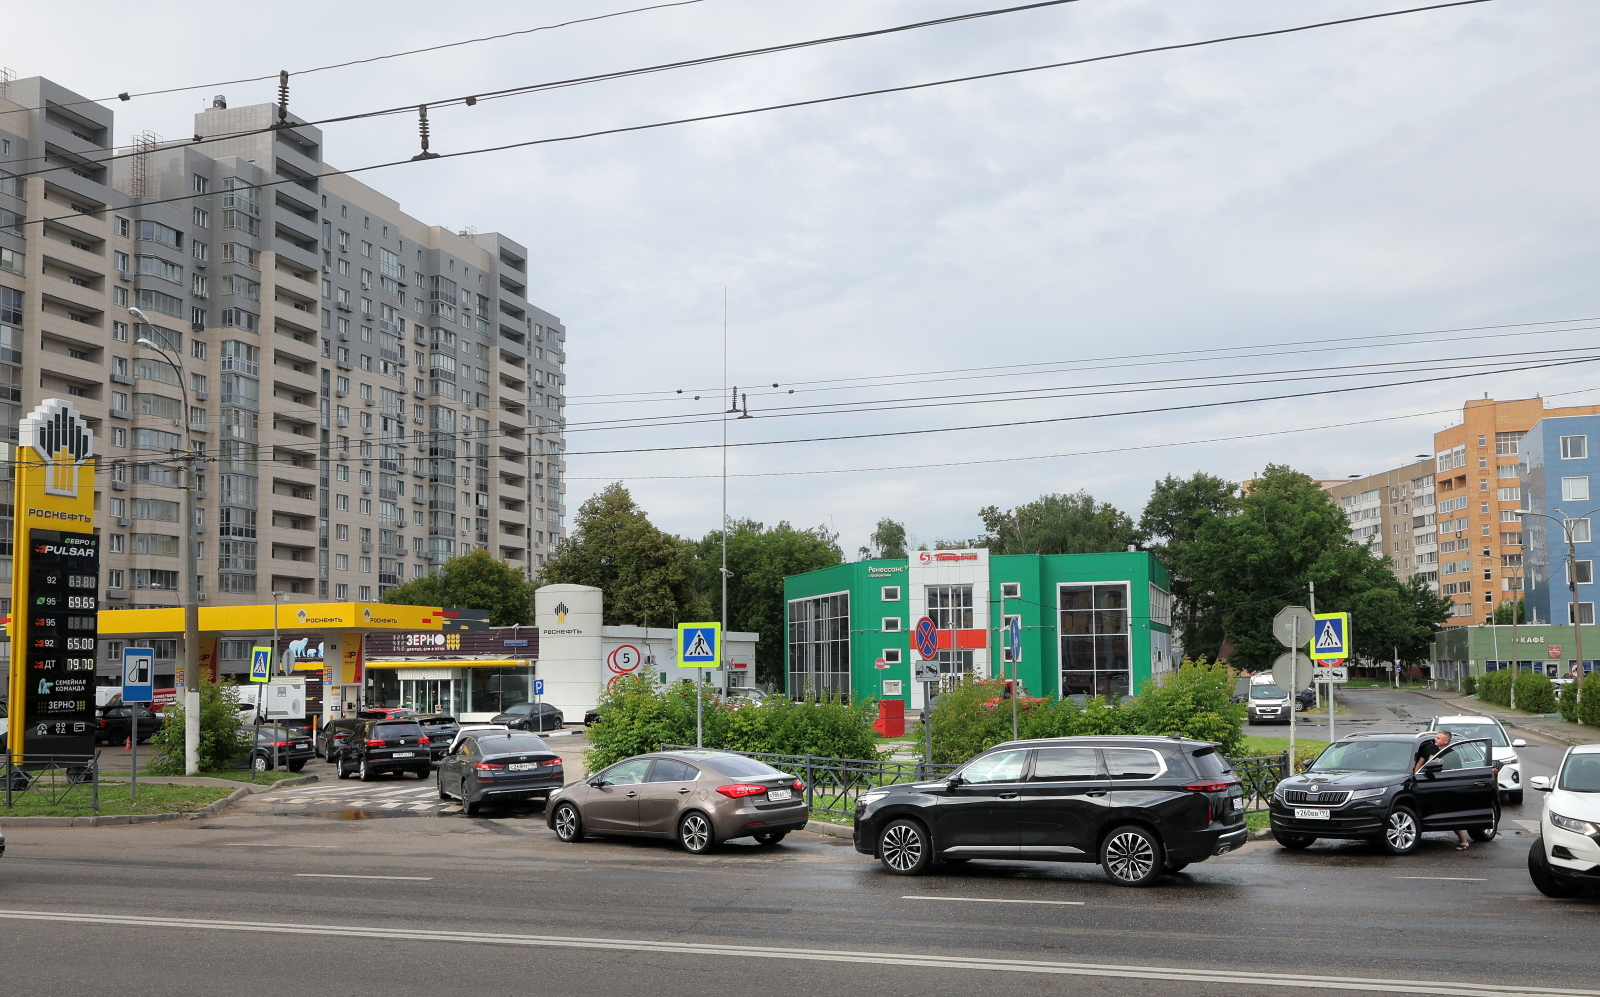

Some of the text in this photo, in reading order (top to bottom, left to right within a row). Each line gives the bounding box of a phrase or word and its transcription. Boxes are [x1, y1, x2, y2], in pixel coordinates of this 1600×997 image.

[28, 508, 91, 523] РОСНЕФТЬ
[70, 538, 90, 546] ЕВРО
[44, 545, 95, 557] PULSAR
[46, 576, 57, 584] 92
[68, 596, 95, 609] 69.65
[45, 618, 56, 626] 95
[44, 638, 94, 650] 92 65.00
[406, 634, 445, 646] ЗЕРНО
[622, 652, 631, 664] 5
[44, 660, 56, 669] ДТ
[55, 678, 87, 686] СЕМЕЙНАЯ
[48, 701, 75, 709] ЗЕРНО
